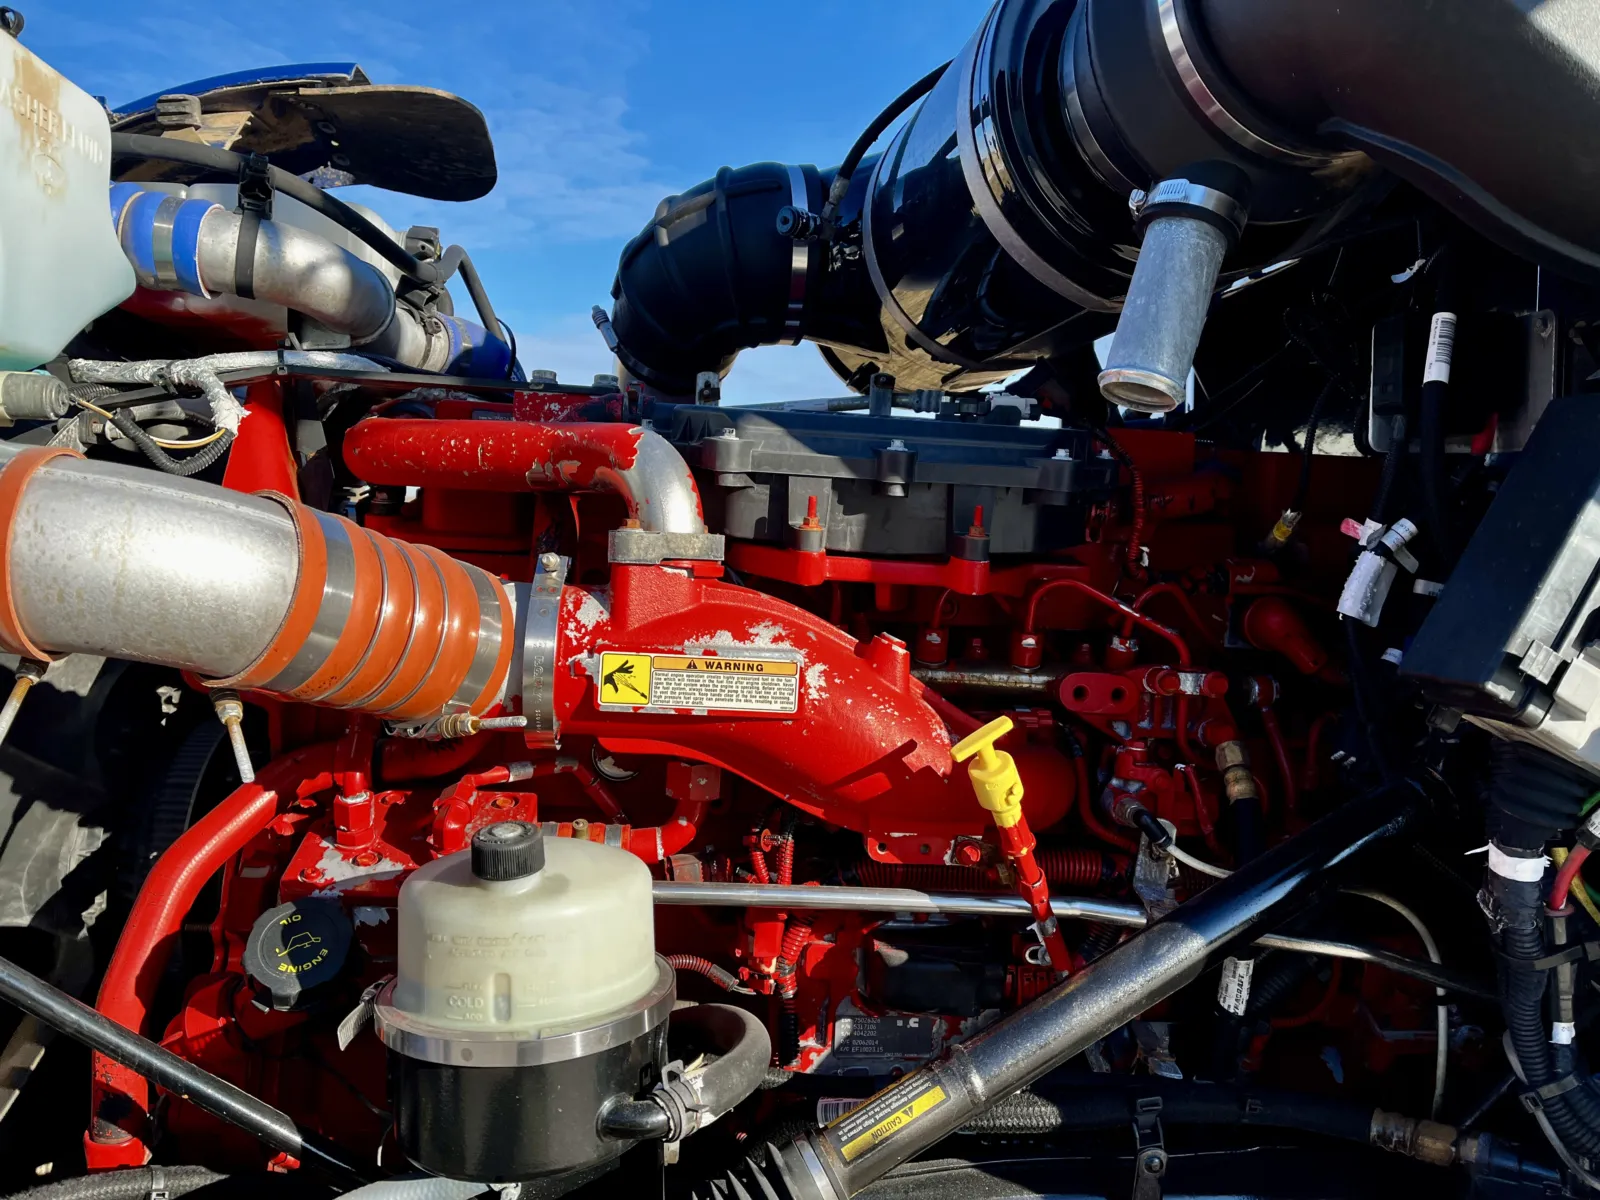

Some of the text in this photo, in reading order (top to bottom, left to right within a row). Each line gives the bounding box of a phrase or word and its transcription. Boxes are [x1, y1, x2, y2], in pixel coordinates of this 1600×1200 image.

[0, 77, 60, 139] ASHER
[705, 661, 764, 671] WARNING
[280, 914, 302, 926] OIL
[278, 948, 329, 973] ENGINE
[446, 995, 484, 1008] COLD
[863, 1117, 874, 1128] Align
[871, 1116, 902, 1140] CAUTION
